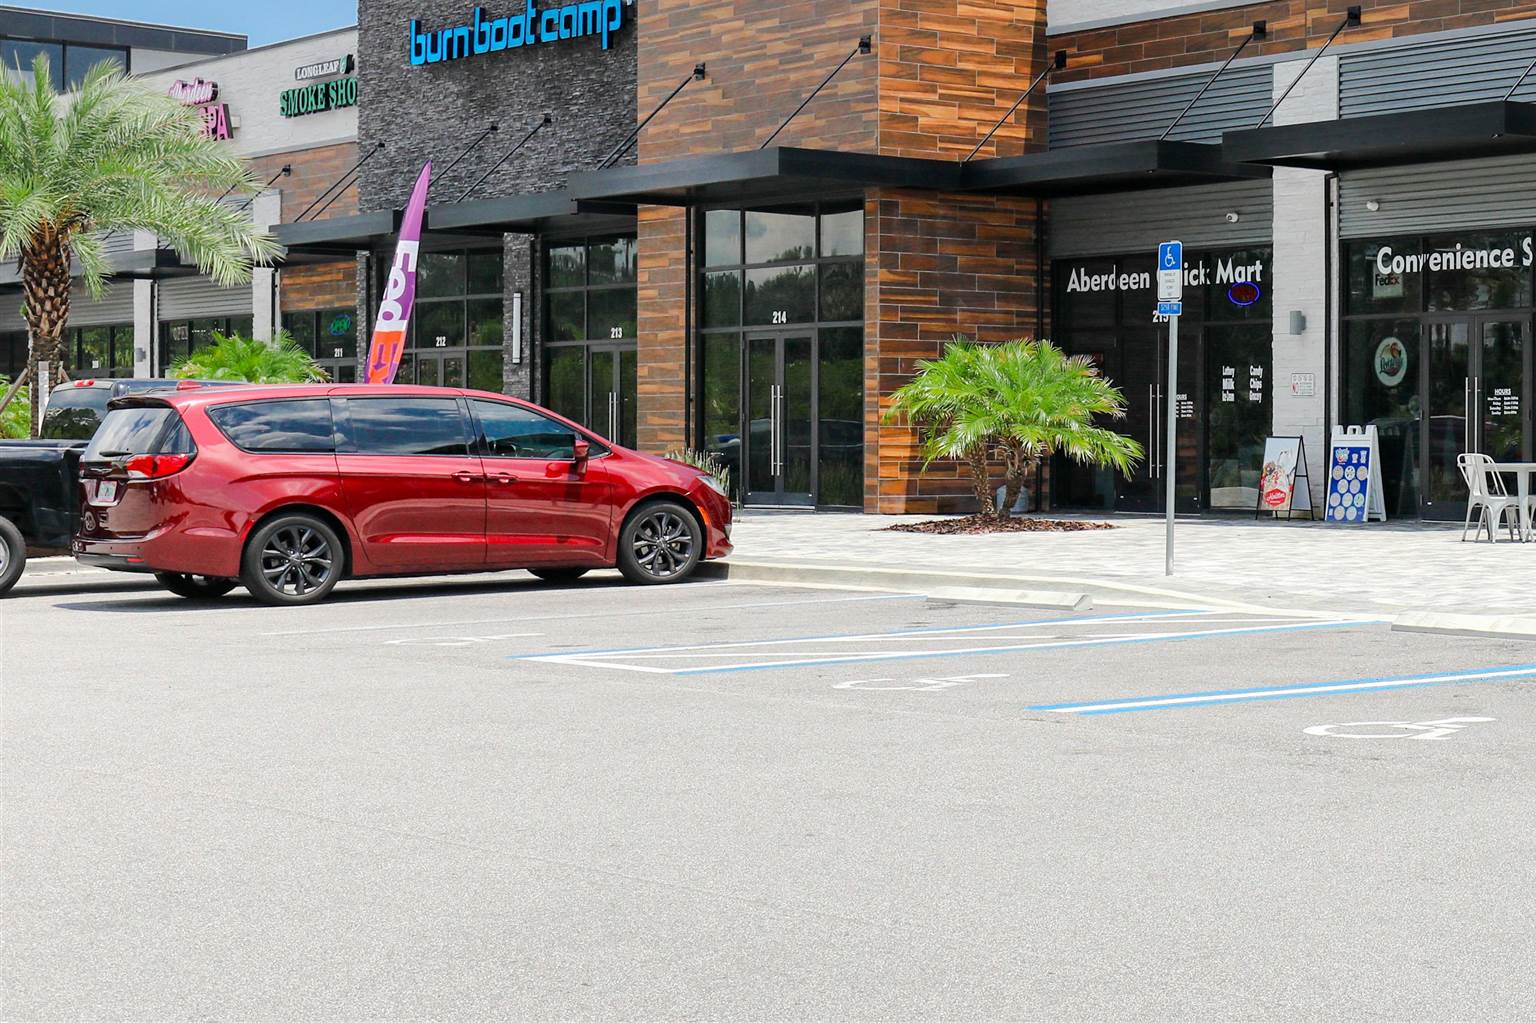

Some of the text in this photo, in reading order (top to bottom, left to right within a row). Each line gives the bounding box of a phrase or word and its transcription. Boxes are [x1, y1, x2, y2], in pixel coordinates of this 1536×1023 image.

[410, 18, 469, 65] burn
[297, 61, 340, 80] LONGLEAF
[280, 82, 326, 117] SMOKE
[1377, 242, 1514, 275] Convenience
[1066, 264, 1150, 293] Aberdeen
[1215, 257, 1263, 285] Mart
[1375, 273, 1400, 287] FedEx
[772, 311, 786, 324] 214
[436, 336, 446, 346] 212
[610, 327, 623, 339] 213
[334, 348, 343, 358] 211
